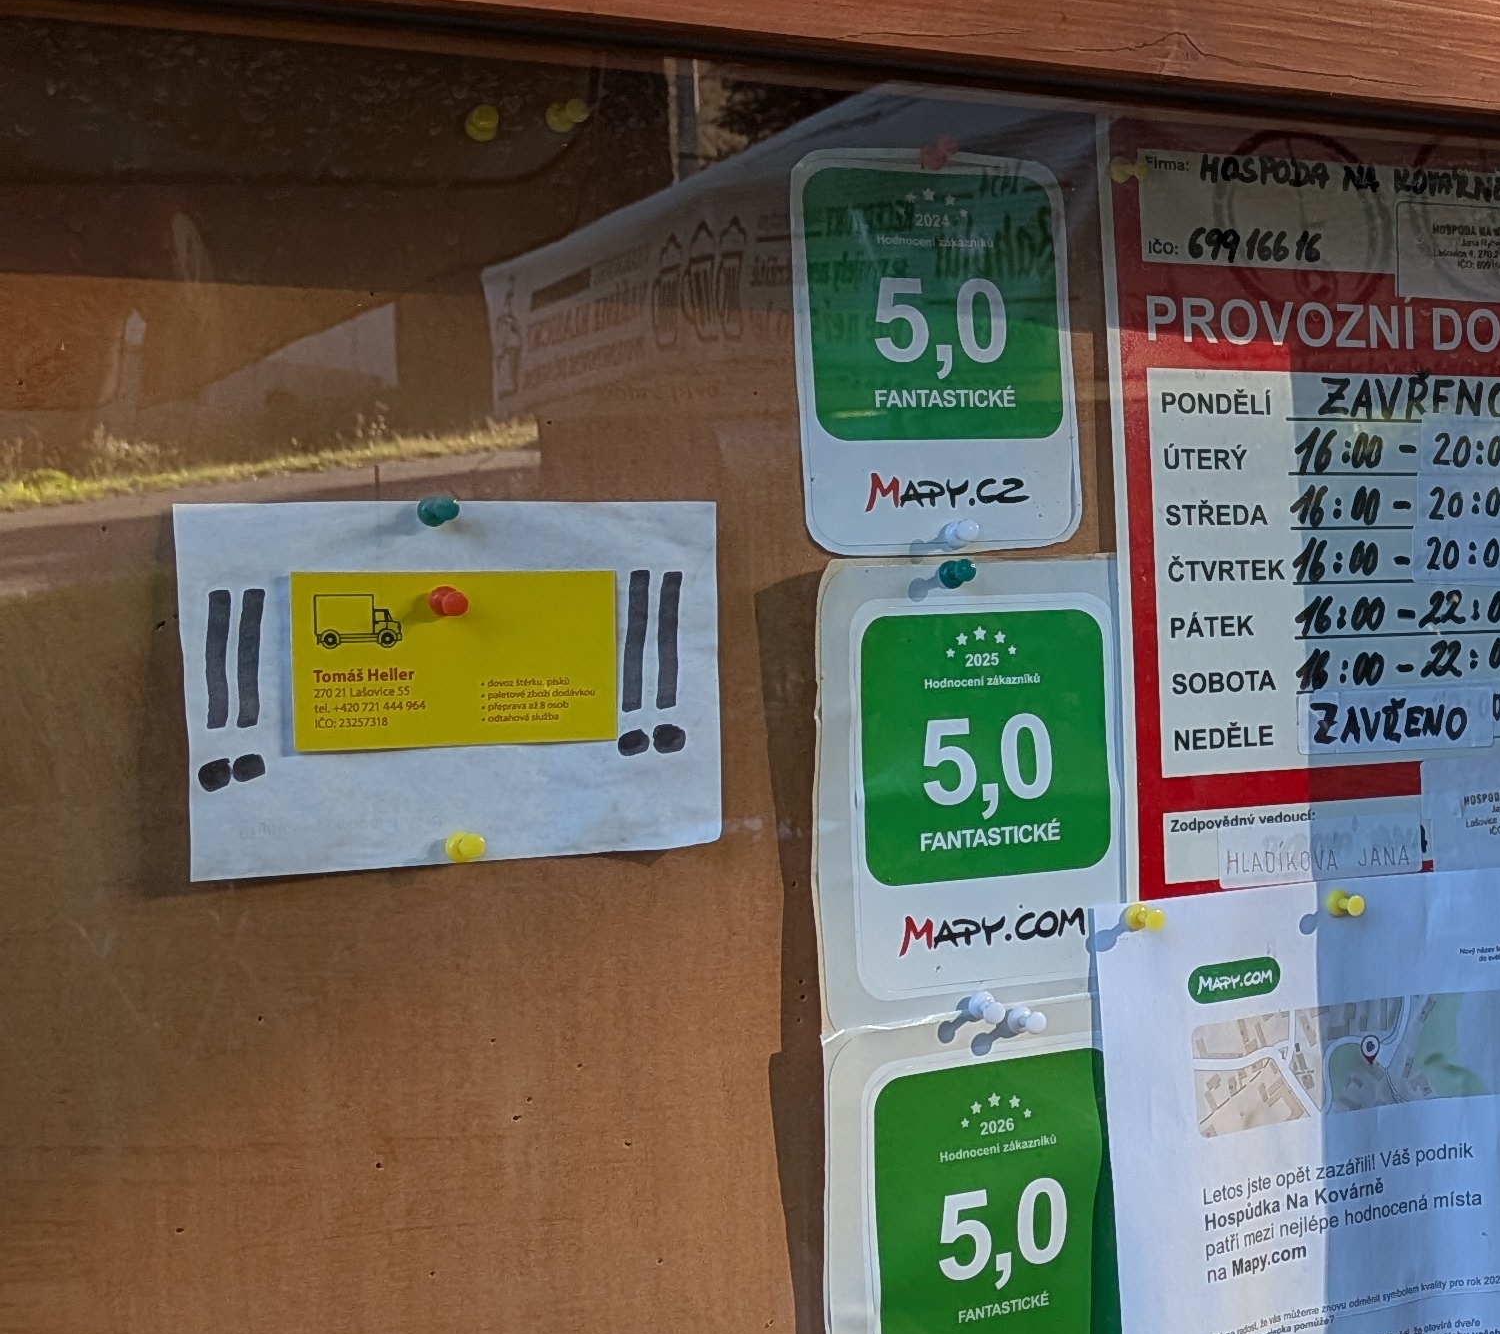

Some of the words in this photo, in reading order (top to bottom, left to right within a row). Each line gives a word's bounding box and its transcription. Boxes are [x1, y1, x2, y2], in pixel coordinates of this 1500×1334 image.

[1145, 155, 1190, 172] Firma:
[1200, 154, 1330, 190] HOSPODA
[1342, 165, 1379, 193] NA
[916, 214, 950, 228] 2024
[1148, 238, 1179, 256] IČO:
[874, 276, 1007, 380] 5,0
[1146, 295, 1414, 351] PROVOZNÍ
[875, 386, 1016, 408] FANTASTICKÉ
[1162, 388, 1271, 416] PONDĚLÍ
[1164, 443, 1247, 470] ÚTERÝ
[1294, 427, 1383, 475] 16:00
[1166, 500, 1268, 526] STŘEDA
[1290, 484, 1380, 527] 16:00
[1168, 555, 1285, 583] ČTVRTEK
[1292, 537, 1379, 582] 16:00
[1170, 611, 1254, 639] PÁTEK
[1295, 595, 1385, 637] 16:00
[965, 653, 1000, 667] 2025
[1172, 669, 1277, 695] SOBOTA
[1296, 648, 1385, 691] 16:00
[313, 668, 363, 683] Tomáš
[367, 667, 415, 681] Heller
[487, 679, 513, 687] dovoz
[924, 676, 984, 690] Hodnocení
[987, 673, 1041, 687] zákazníků
[314, 688, 333, 698] 270
[335, 688, 346, 698] 21
[350, 687, 395, 697] Lašovice
[398, 686, 410, 696] 55
[487, 690, 526, 701] paletové
[488, 702, 526, 712] přeprava
[540, 701, 546, 709] 8
[547, 700, 569, 709] osob
[314, 703, 330, 714] tel.
[333, 702, 360, 713] +420
[362, 702, 380, 712] 721
[383, 701, 403, 711] 444
[405, 700, 426, 710] 964
[487, 713, 530, 723] odtahová
[315, 717, 336, 728] IČO:
[339, 717, 388, 728] 23257318
[1174, 721, 1274, 752] NEDĚLE
[923, 713, 1053, 820] 5,0
[920, 818, 1061, 852] FANTASTICKÉ
[1170, 814, 1254, 834] Zodpovědný
[1259, 809, 1316, 827] vedoucí:
[1358, 844, 1410, 868] JANA
[980, 1118, 1015, 1136] 2026
[939, 1142, 1000, 1163] Hodnocení
[1002, 1134, 1057, 1155] zákazníků
[1203, 1181, 1243, 1205] Letos
[1246, 1176, 1271, 1199] jste
[1276, 1166, 1311, 1189] opět
[1316, 1153, 1375, 1180] zazářili!
[1380, 1148, 1410, 1168] Váš
[1416, 1142, 1474, 1166] podnik
[1205, 1198, 1280, 1231] Hospůdka
[1287, 1191, 1309, 1210] Na
[1315, 1177, 1384, 1206] Kovárně
[938, 1177, 1068, 1290] 5,0
[1205, 1234, 1240, 1261] patří
[1244, 1223, 1274, 1247] mezi
[1280, 1212, 1339, 1238] nejlépe
[1345, 1194, 1428, 1225] hodnocená
[1433, 1191, 1482, 1208] místa
[1208, 1266, 1227, 1283] na
[1232, 1244, 1307, 1277] Mapy.com
[1450, 1279, 1464, 1289] pro
[1467, 1277, 1482, 1286] rok
[958, 1291, 1050, 1324] FANTASTICKÉ
